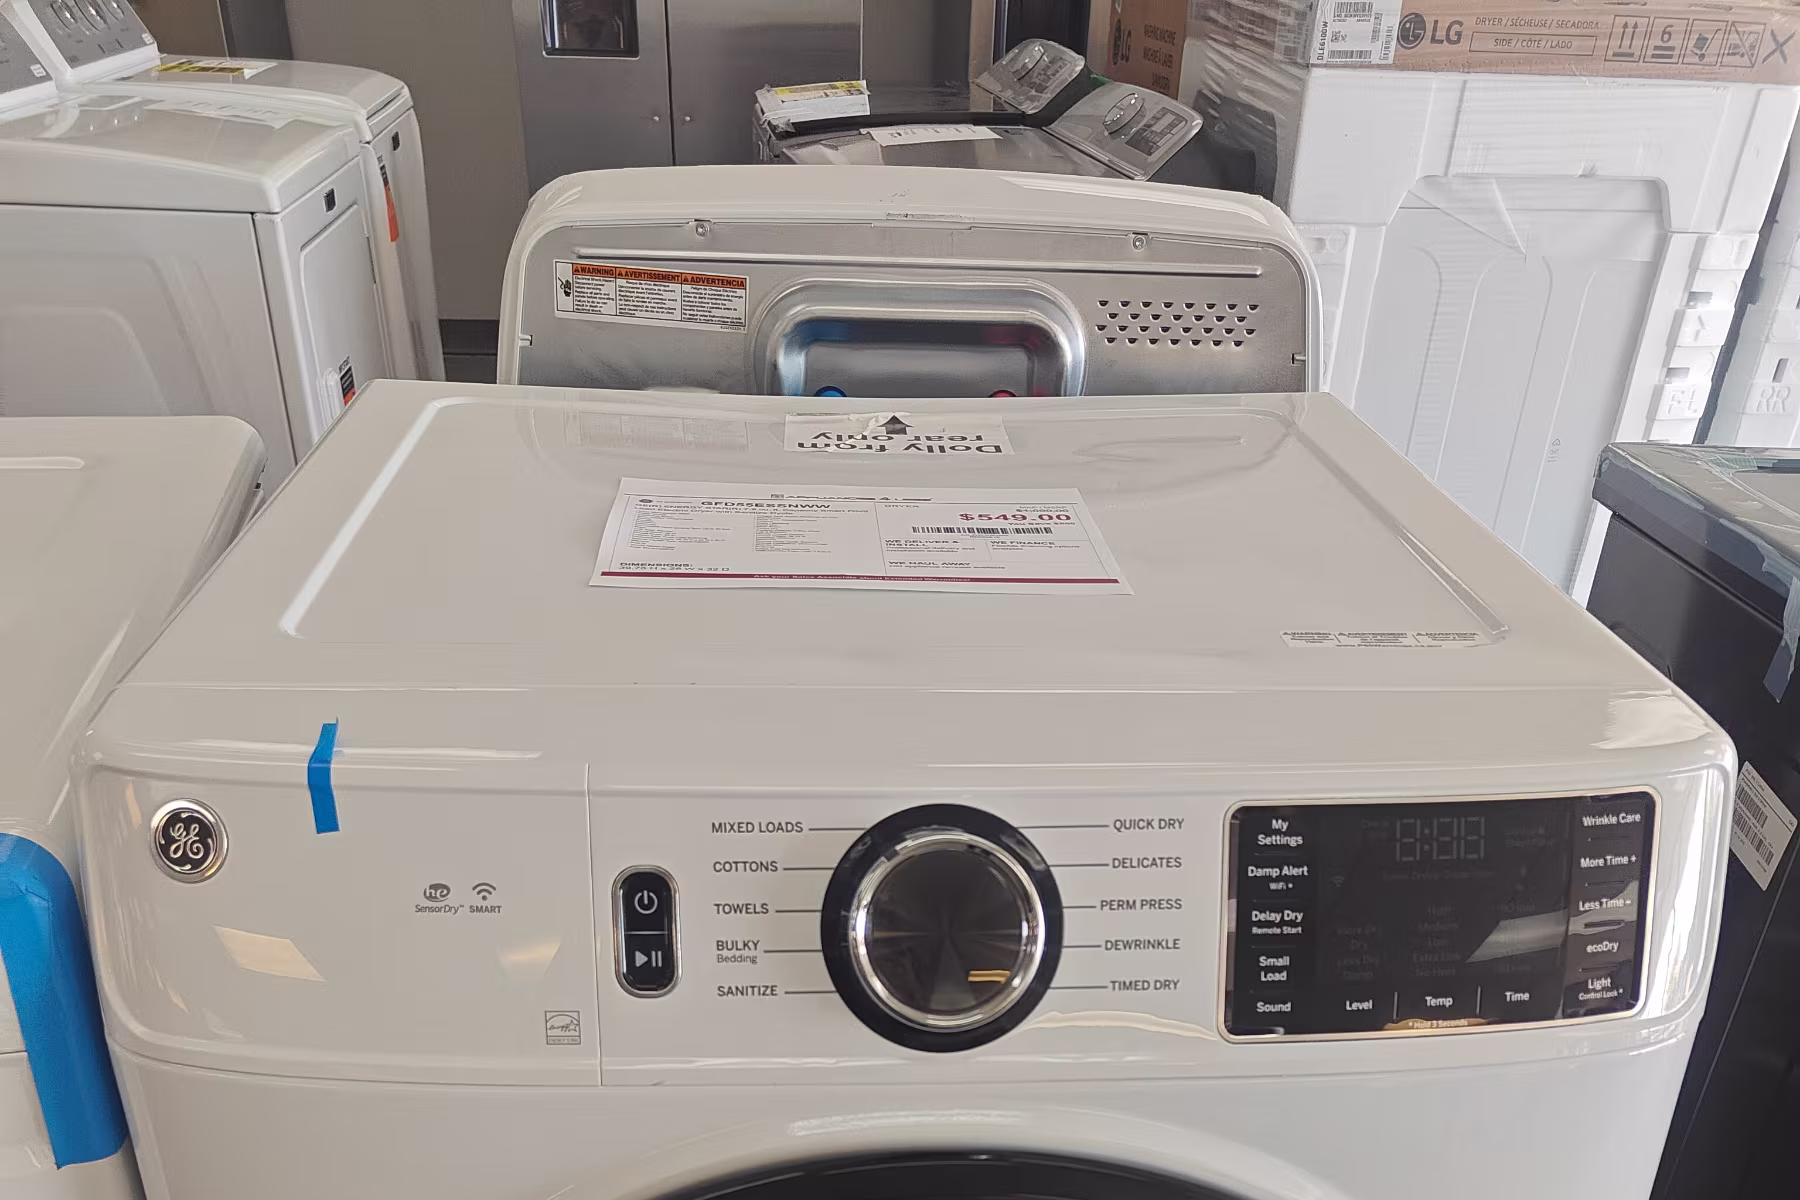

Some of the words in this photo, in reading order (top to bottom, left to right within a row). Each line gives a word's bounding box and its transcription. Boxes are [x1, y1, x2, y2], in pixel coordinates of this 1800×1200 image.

[1475, 17, 1502, 26] DRYER
[1510, 16, 1548, 28] SÉCHEUSE
[1556, 20, 1599, 30] SECADORA
[1430, 19, 1464, 45] LG
[1661, 25, 1674, 43] 6
[1494, 38, 1512, 47] SIDE
[1521, 37, 1542, 48] CÔTÉ
[1550, 39, 1573, 49] LADO
[580, 267, 614, 276] WARNING
[625, 270, 680, 281] AVERTISSEMENT
[690, 276, 745, 287] ADVERTENCIA
[1757, 387, 1790, 412] RR
[812, 432, 894, 441] only
[798, 443, 888, 452] from
[903, 443, 1003, 453] Dolly
[959, 513, 1071, 521] $549.00
[1113, 819, 1155, 832] QUICK
[1158, 818, 1185, 830] DRY
[1272, 819, 1289, 831] My
[1582, 814, 1618, 827] Wrinkle
[1619, 812, 1641, 823] Care
[711, 822, 755, 833] MIXED
[758, 821, 804, 833] LOADS
[1257, 834, 1303, 847] Settings
[713, 861, 778, 873] COTTONS
[1112, 857, 1183, 869] DELICATES
[1580, 857, 1604, 868] More
[1605, 855, 1629, 866] Time
[1248, 866, 1280, 878] Damp
[1282, 866, 1308, 876] Alert
[1269, 882, 1286, 890] WiFi
[469, 905, 502, 913] SMART
[714, 903, 769, 915] TOWELS
[1100, 900, 1137, 911] PERM
[1140, 898, 1183, 910] PRESS
[1579, 900, 1600, 911] Less
[1601, 898, 1624, 909] Time
[1251, 910, 1282, 922] Delay
[1284, 910, 1303, 922] Dry
[1252, 927, 1281, 935] Remote
[1283, 926, 1302, 934] Start
[716, 940, 760, 952] BULKY
[1104, 938, 1181, 951] DEWRINKLE
[1586, 942, 1619, 953] ecoDry
[717, 954, 758, 965] Bedding
[1259, 956, 1290, 966] Small
[1260, 971, 1287, 981] Load
[1110, 980, 1151, 992] TIMED
[1154, 979, 1180, 991] DRY
[1588, 976, 1611, 990] Light
[717, 985, 778, 997] SANITIZE
[1505, 991, 1530, 1002] Time
[1579, 991, 1602, 1000] Control
[1602, 990, 1618, 999] Lock
[1256, 1002, 1291, 1012] Sound
[1346, 1000, 1373, 1011] Level
[1425, 996, 1453, 1008] Temp
[1438, 1019, 1467, 1027] Seconds
